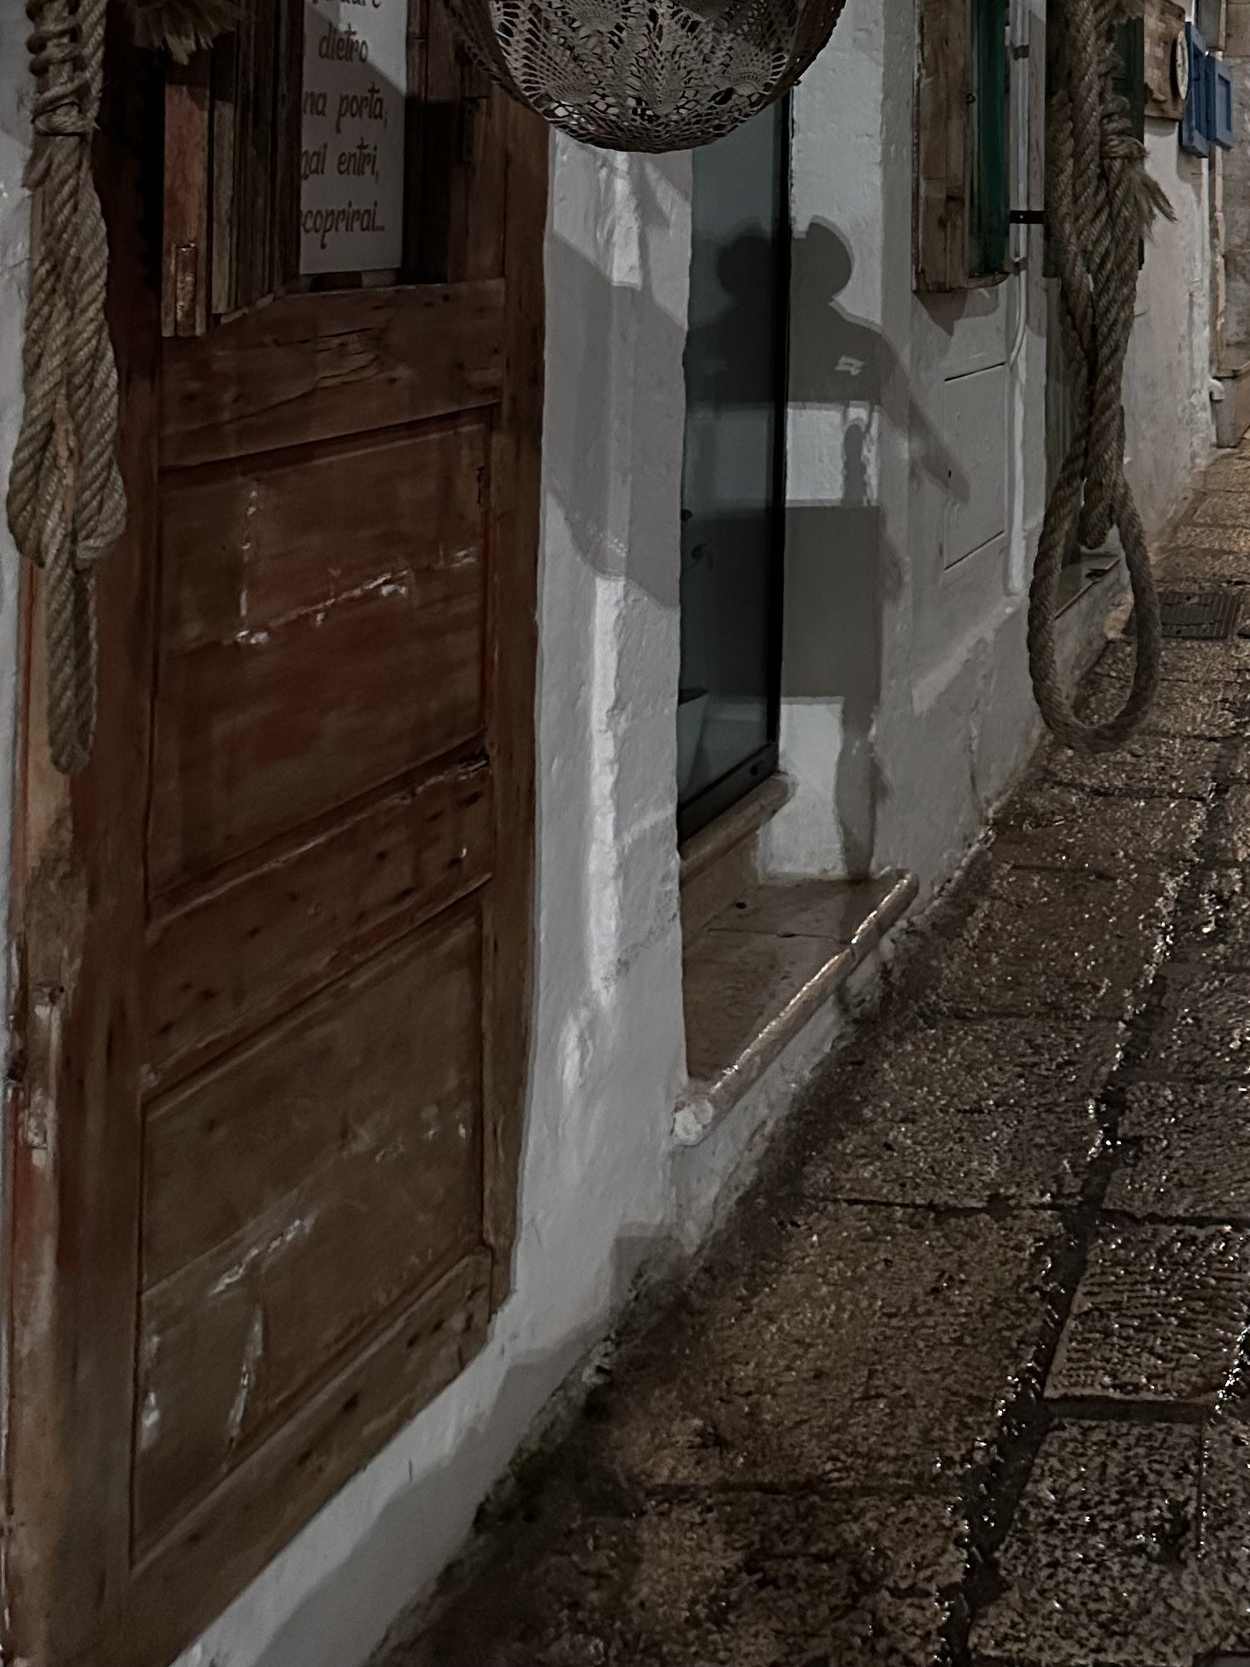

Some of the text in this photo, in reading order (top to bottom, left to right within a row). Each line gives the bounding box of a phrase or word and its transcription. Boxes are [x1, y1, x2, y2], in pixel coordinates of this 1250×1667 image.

[318, 21, 369, 63] dietro
[303, 91, 327, 117] na
[301, 200, 385, 250] coprirai...
